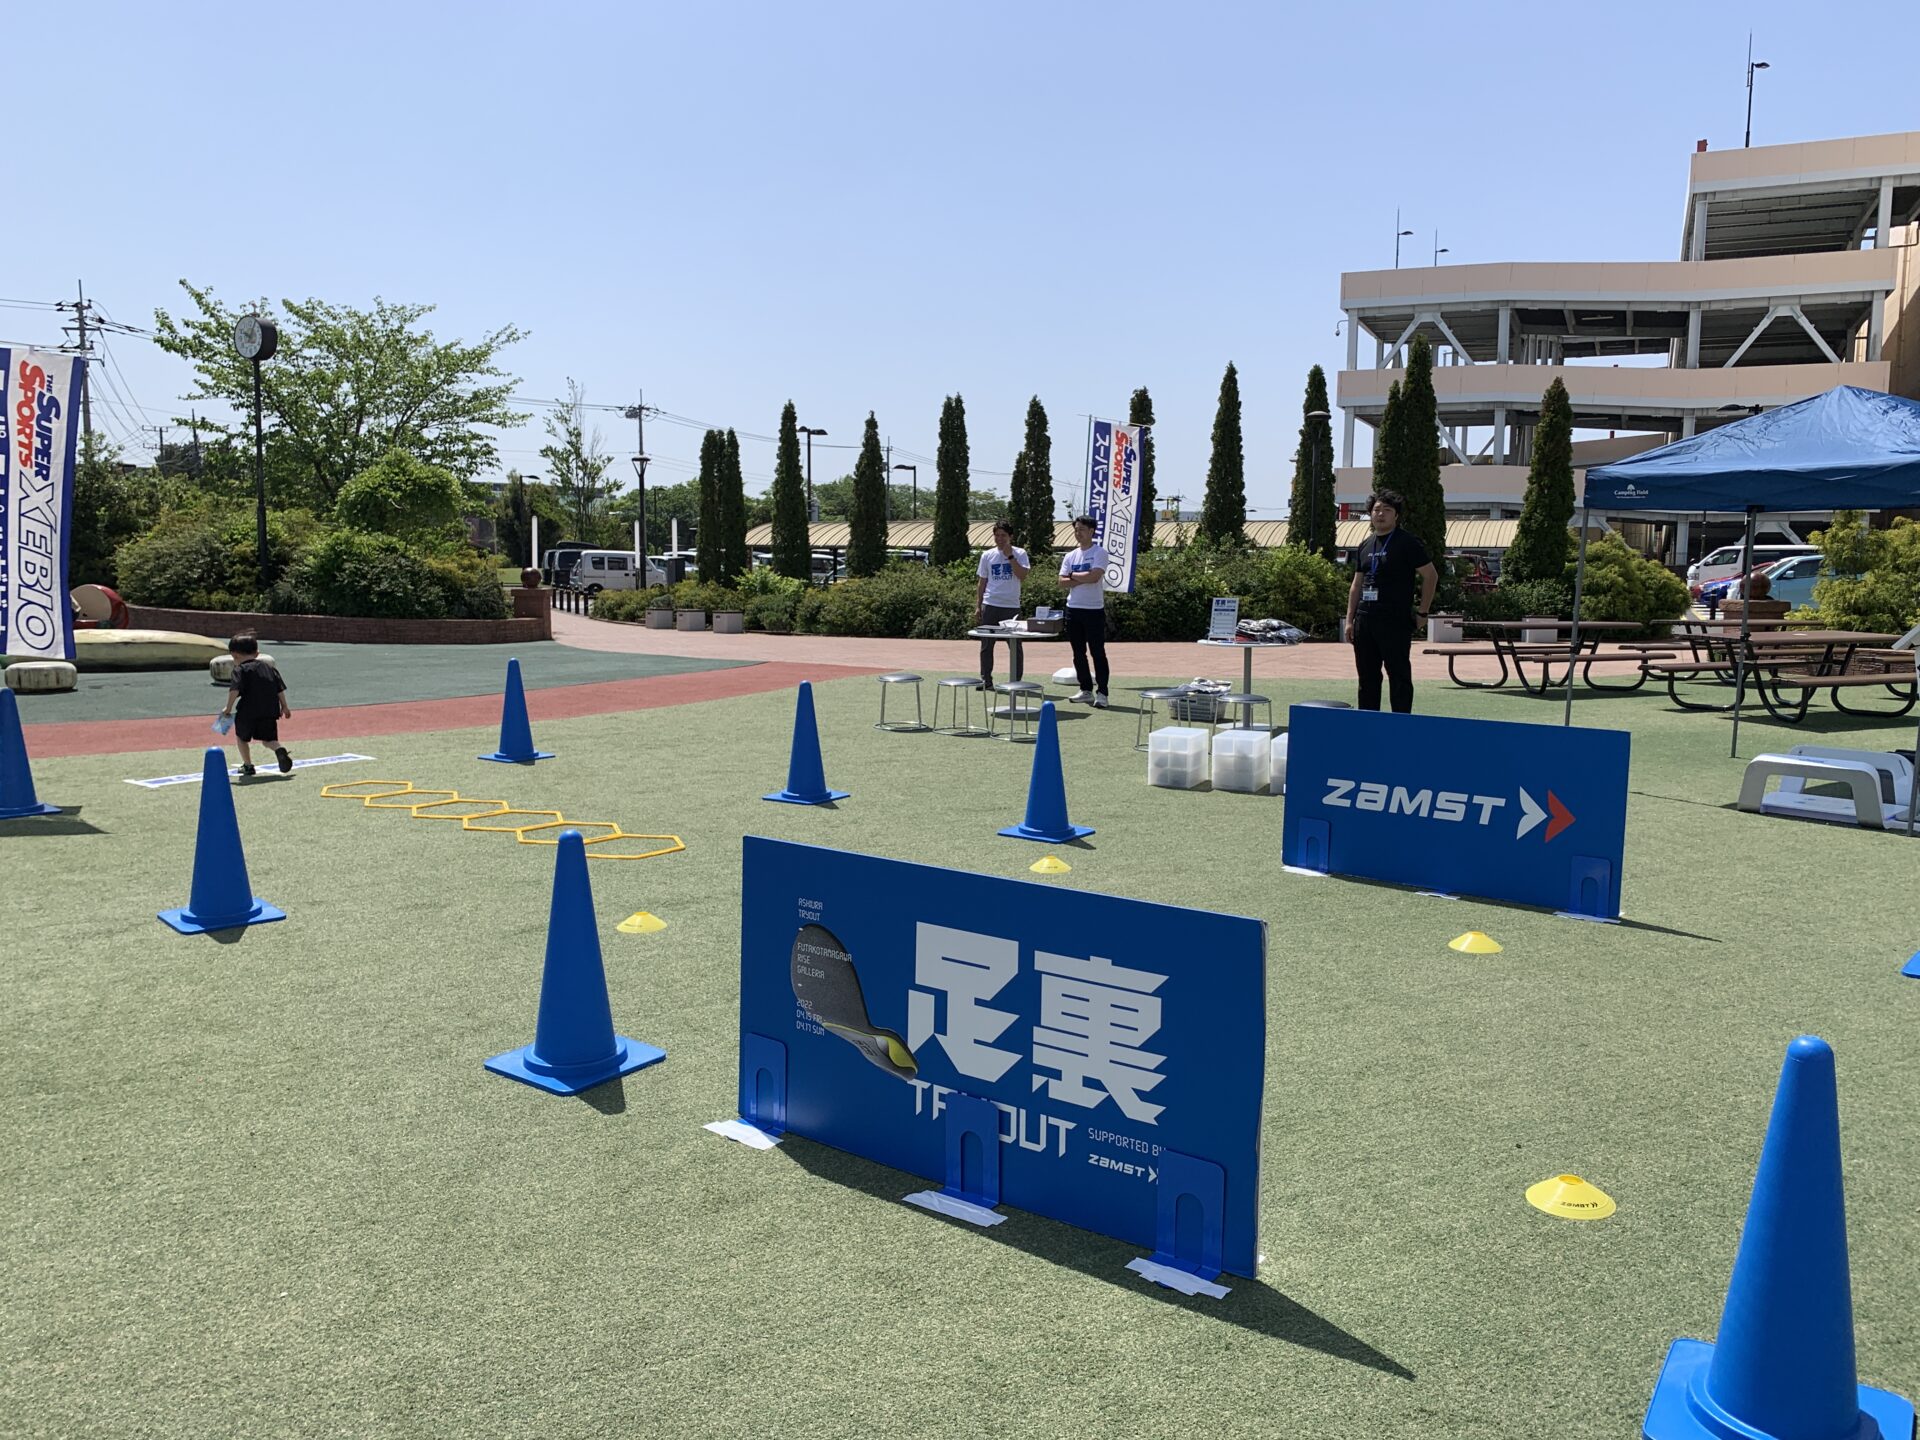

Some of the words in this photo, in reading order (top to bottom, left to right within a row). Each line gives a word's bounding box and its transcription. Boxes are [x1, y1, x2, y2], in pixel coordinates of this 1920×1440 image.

[46, 374, 54, 394] THE
[16, 360, 45, 470] SPORTS
[34, 390, 61, 482] SUPER
[1112, 430, 1129, 490] SPORTS
[1121, 447, 1137, 496] SUPER
[1104, 489, 1132, 588] XEBIO
[15, 470, 57, 651] XEBIO
[798, 898, 823, 911] ASHIURA
[798, 909, 821, 922] TRYOUT
[797, 942, 852, 962] FUTAKOTAMAGAWA
[797, 954, 811, 965] RISE
[797, 965, 825, 980] GALLERIA
[796, 999, 813, 1010] 2022
[907, 920, 1170, 1126] 足裏
[1088, 1127, 1149, 1154] SUPPORTED
